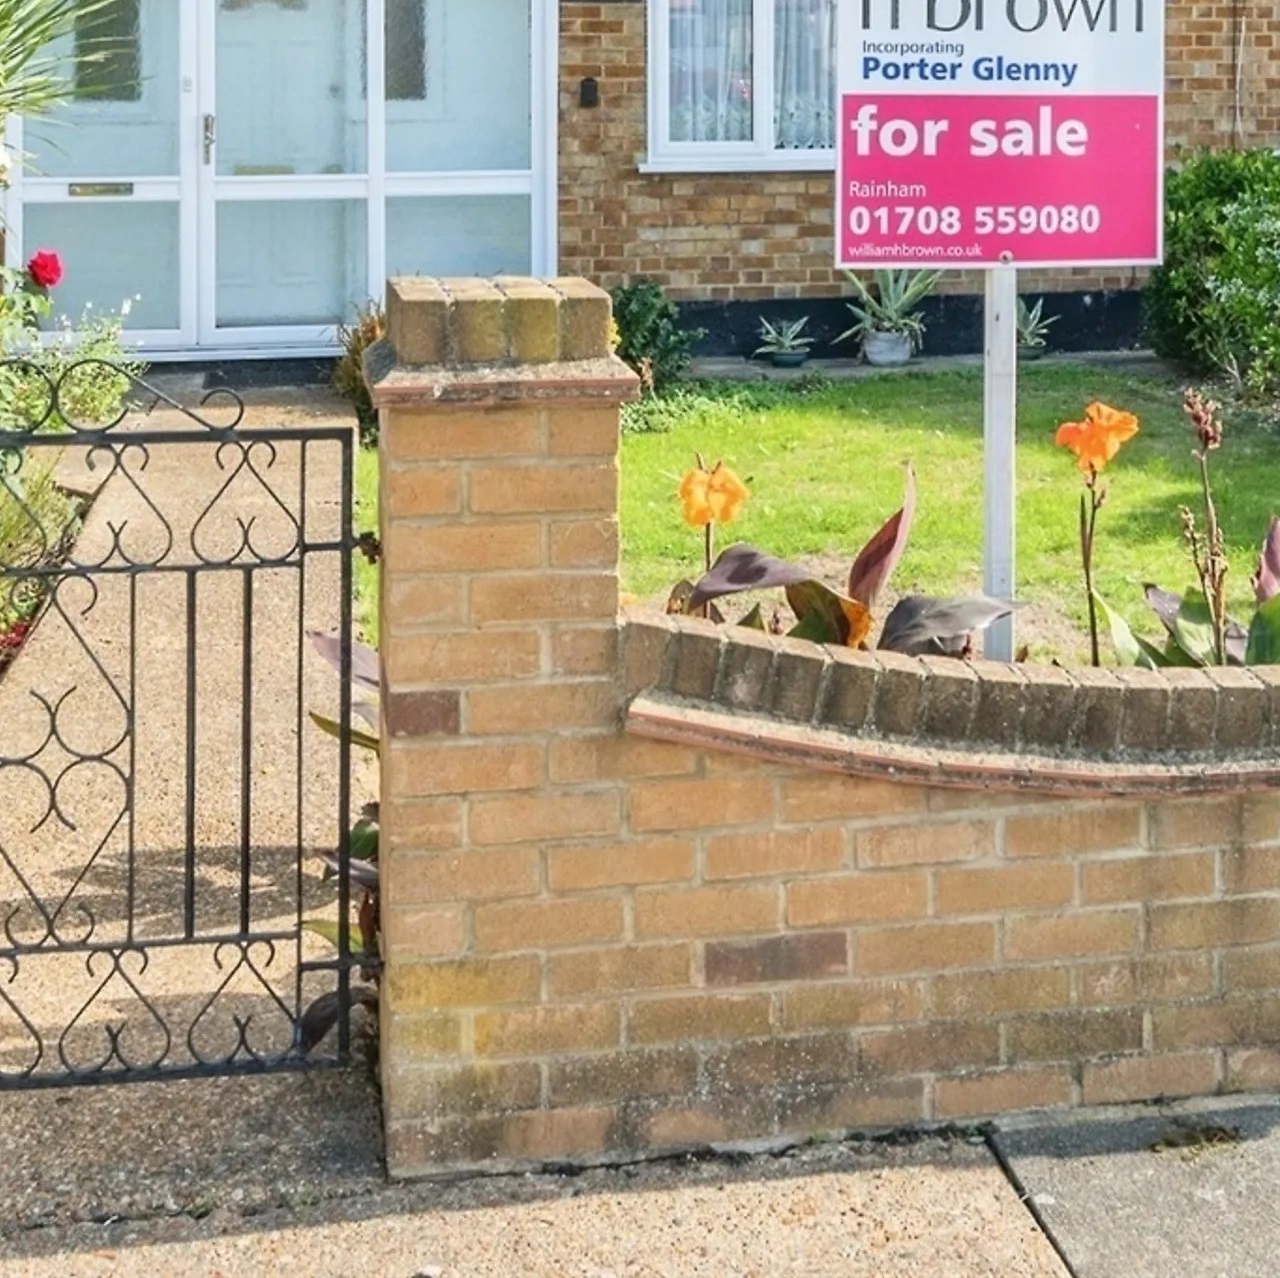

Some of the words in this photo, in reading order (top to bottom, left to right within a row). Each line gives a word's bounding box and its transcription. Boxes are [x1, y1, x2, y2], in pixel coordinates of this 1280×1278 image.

[862, 40, 964, 56] Incorporating
[862, 57, 963, 80] Porter
[972, 57, 1077, 87] Glenny
[851, 105, 949, 157] for
[969, 106, 1088, 157] sale
[849, 181, 926, 198] Rainham
[849, 206, 961, 235] 01708
[974, 204, 1100, 235] 559080
[849, 242, 983, 257] williamhbrown.co.uk
